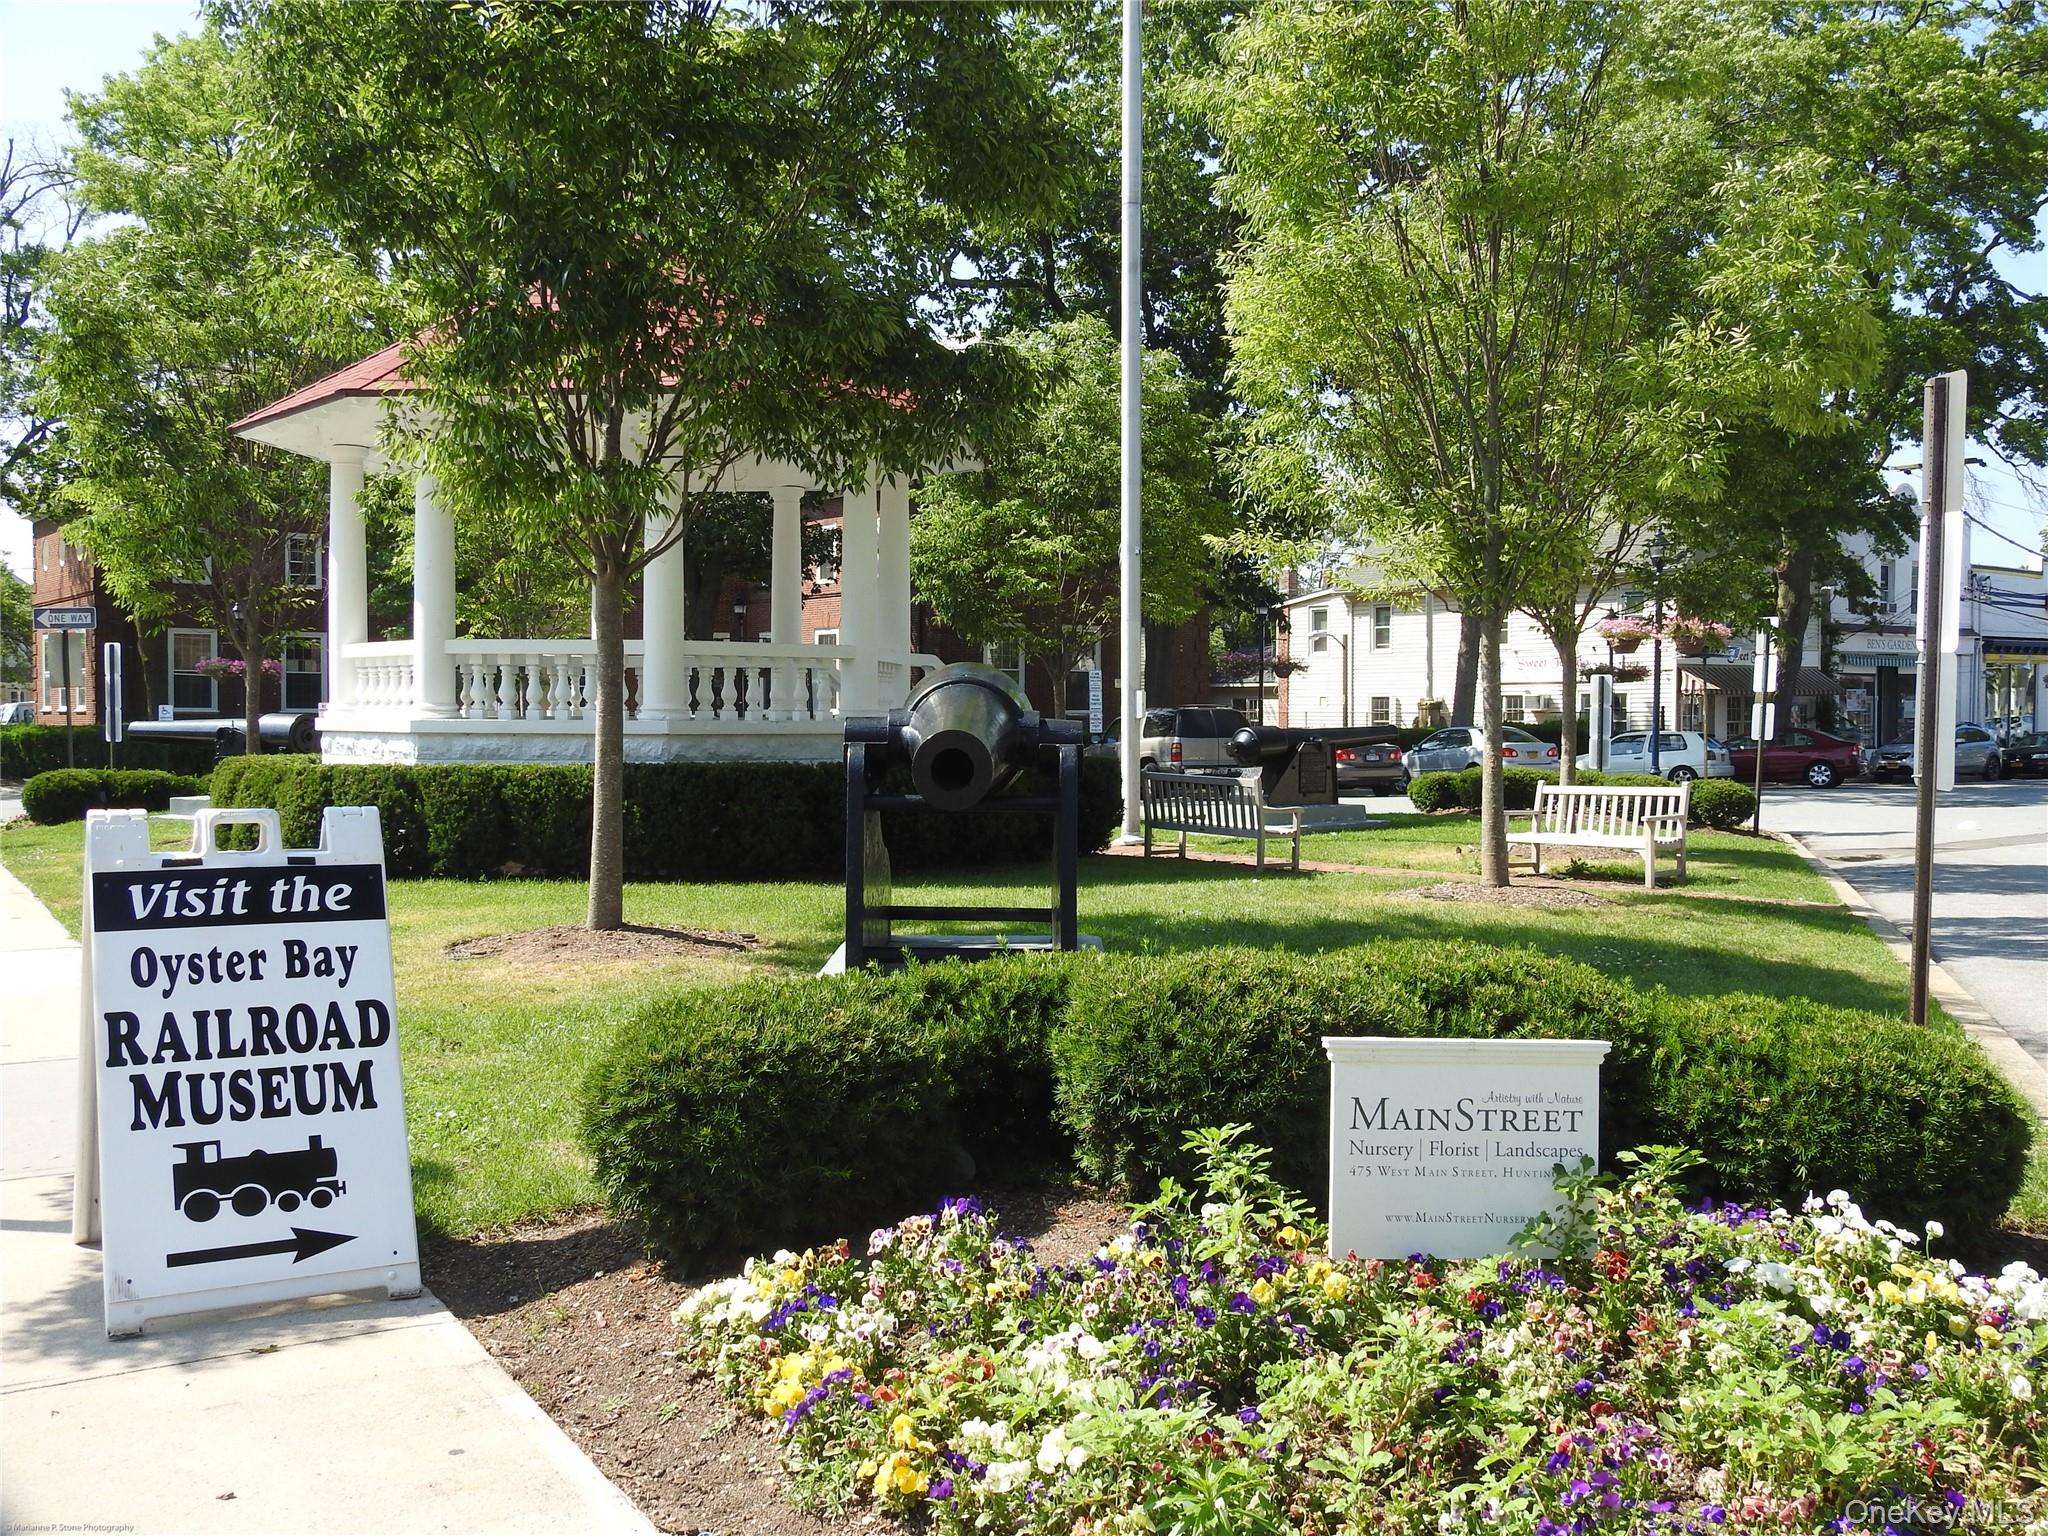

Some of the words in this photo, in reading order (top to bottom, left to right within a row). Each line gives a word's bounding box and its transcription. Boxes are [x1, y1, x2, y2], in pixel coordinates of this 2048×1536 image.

[47, 614, 66, 623] ONE
[70, 614, 90, 623] WAY
[1887, 639, 1917, 651] GARDEN
[128, 877, 252, 920] Visit
[269, 875, 353, 913] the
[130, 945, 267, 999] Oyster
[282, 939, 359, 989] Bay
[104, 998, 391, 1067] RAILROAD
[129, 1059, 378, 1131] MUSEUM
[1481, 1090, 1522, 1107] Artistry
[1525, 1091, 1544, 1104] with
[1546, 1091, 1584, 1105] Nature
[1349, 1139, 1414, 1161] Nursery
[1429, 1140, 1480, 1158] Florist
[1495, 1141, 1584, 1163] Landscapes
[1349, 1165, 1372, 1177] 475
[1378, 1165, 1410, 1177] WEST
[1414, 1166, 1448, 1178] MAIN
[1452, 1165, 1498, 1179] STREET,
